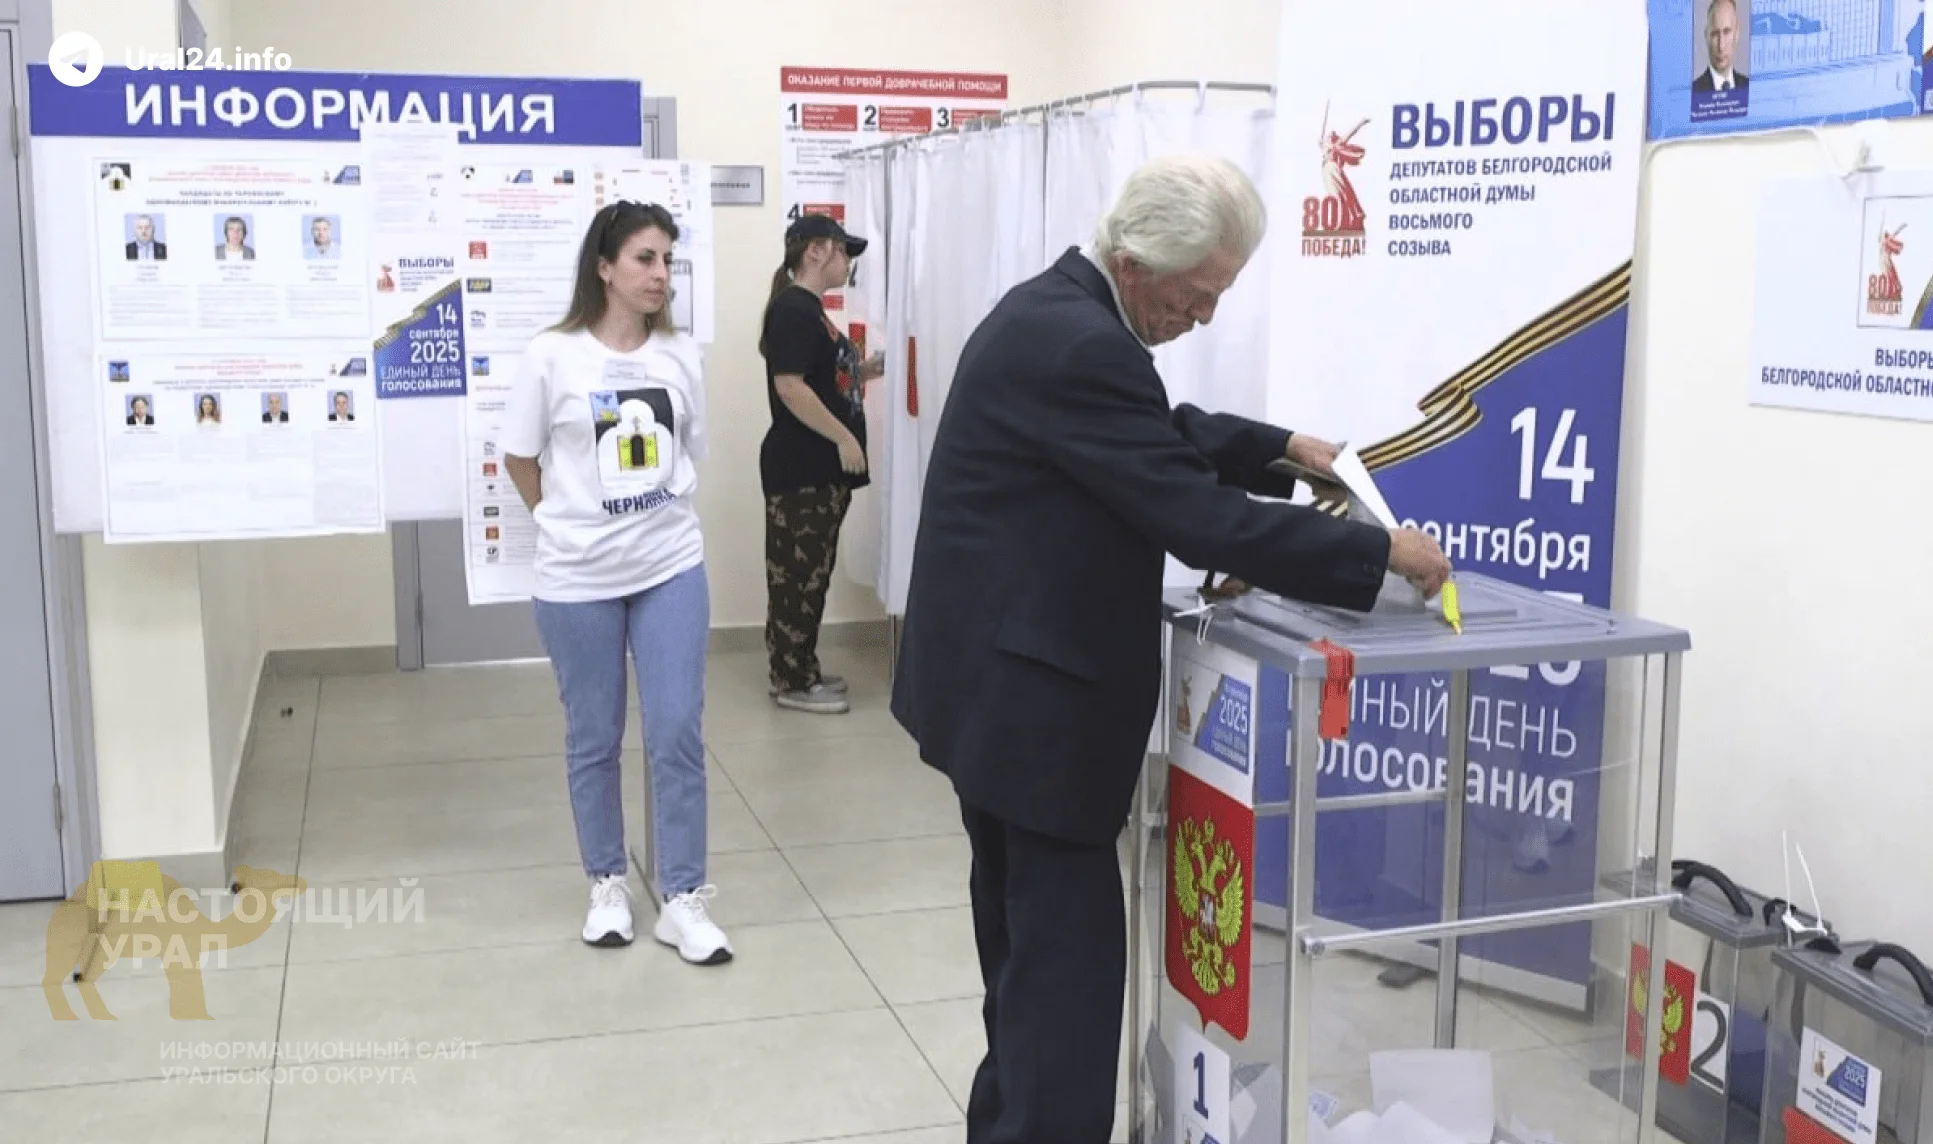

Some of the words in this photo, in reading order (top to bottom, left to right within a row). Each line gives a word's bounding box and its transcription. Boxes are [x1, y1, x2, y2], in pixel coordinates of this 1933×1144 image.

[788, 74, 841, 87] ОКАЗАНИЕ
[843, 75, 883, 88] ПЕРВОЙ
[125, 83, 555, 141] ИНФОРМАЦИЯ
[788, 103, 798, 123] 1
[864, 105, 877, 125] 2
[937, 107, 949, 128] 3
[1392, 92, 1616, 150] ВЫБОРЫ
[1390, 159, 1477, 180] ДЕПУТАТОВ
[1482, 151, 1612, 177] БЕЛГОРОДСКОЙ
[1389, 183, 1481, 205] ОБЛАСТНОЙ
[1485, 184, 1536, 205] ДУМЫ
[1303, 196, 1341, 231] 80
[1389, 212, 1473, 231] ВОСЬМОГО
[1302, 238, 1366, 259] ПОБЕДА!
[1388, 239, 1451, 257] СОЗЫВА
[436, 303, 458, 324] 14
[409, 327, 459, 341] сентября
[410, 342, 460, 364] 2025
[382, 379, 462, 392] голосования
[1761, 366, 1862, 391] БЕЛГОРОДСКОЙ
[1866, 374, 1933, 398] ОБЛАСТН
[1510, 406, 1595, 504] 14
[1400, 517, 1591, 579] нтября
[1219, 695, 1248, 736] 2025
[1468, 694, 1577, 758] ДЕНЬ
[1691, 1000, 1727, 1093] 2
[1193, 1050, 1209, 1120] 1
